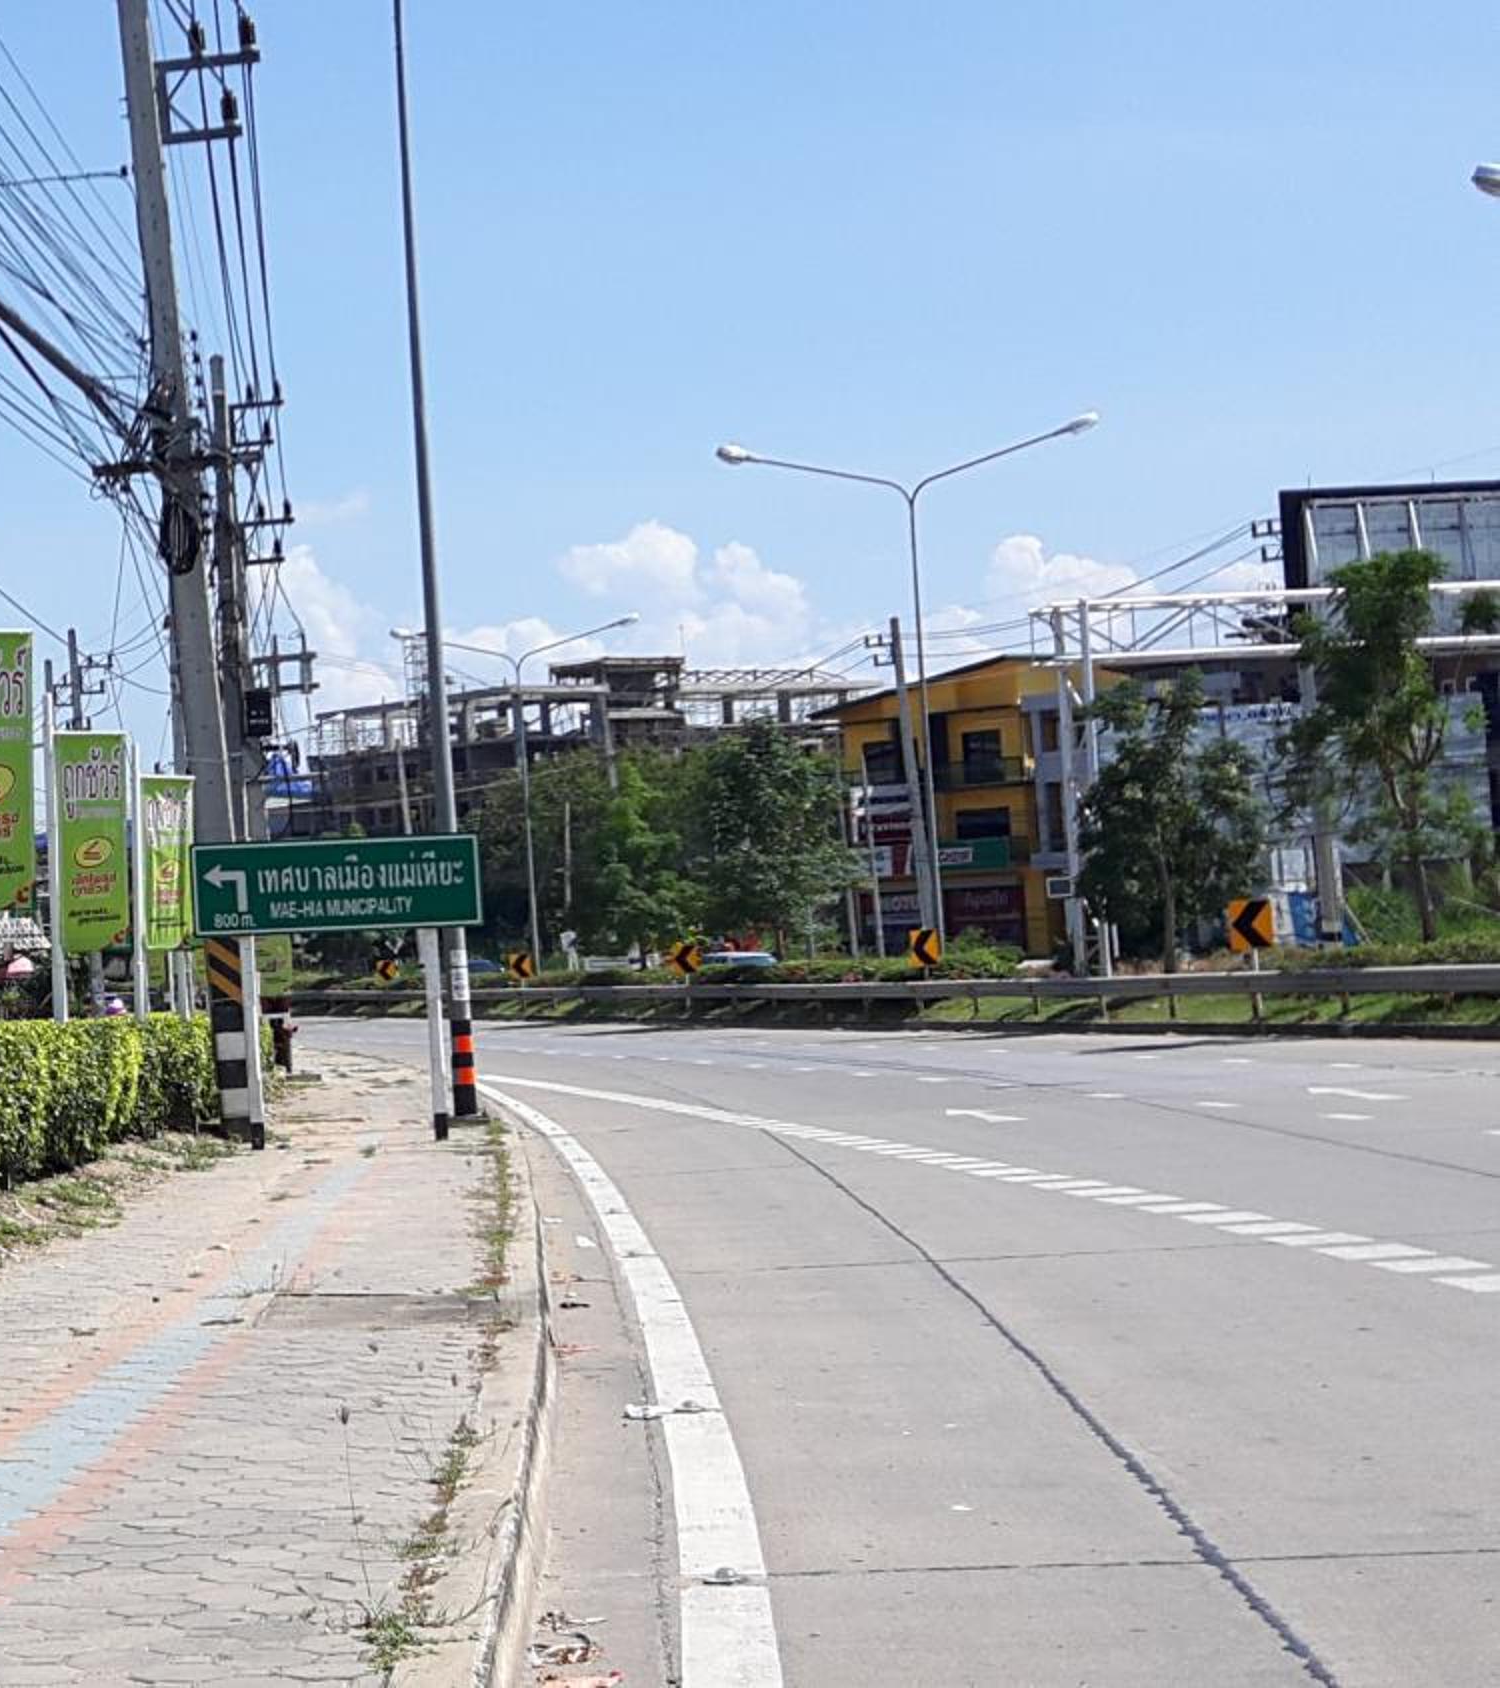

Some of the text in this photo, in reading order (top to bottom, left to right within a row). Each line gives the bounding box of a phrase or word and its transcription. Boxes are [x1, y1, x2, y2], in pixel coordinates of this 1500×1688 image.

[257, 850, 465, 894] เทศบาลเมืองแม่เหียะ
[269, 896, 413, 919] MAE-HIA MUNICIPALITY
[213, 914, 239, 929] 800
